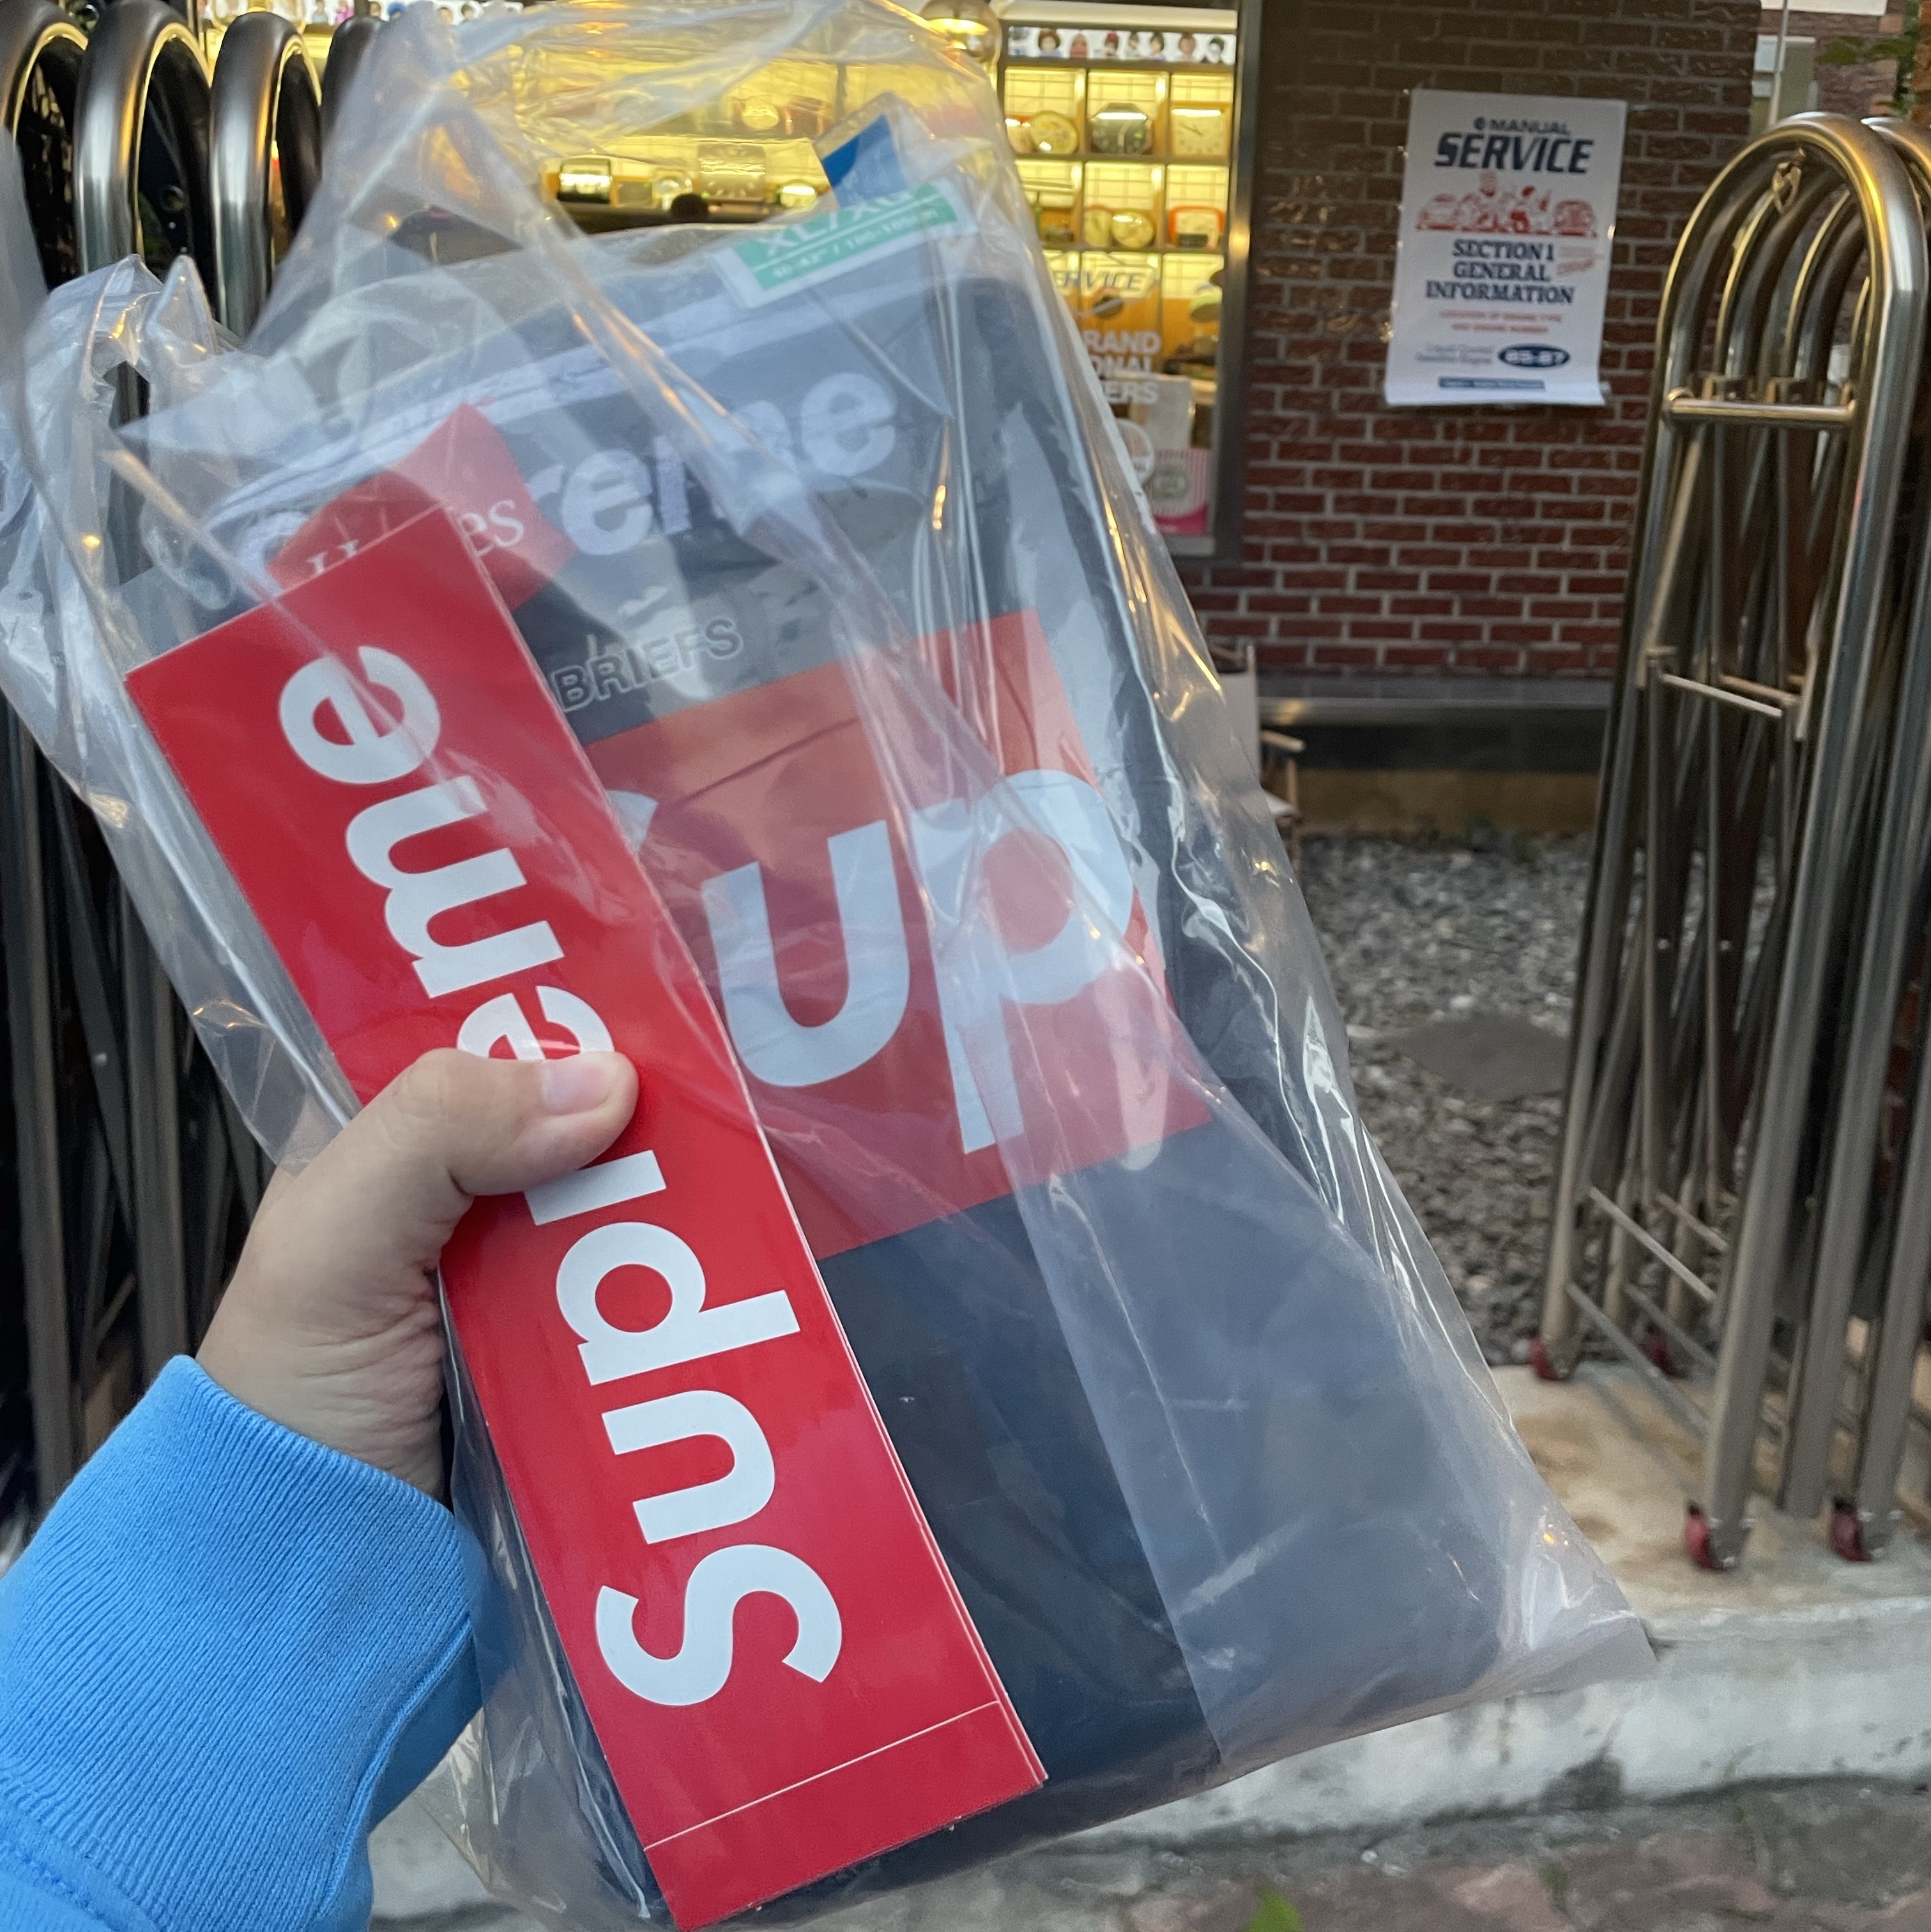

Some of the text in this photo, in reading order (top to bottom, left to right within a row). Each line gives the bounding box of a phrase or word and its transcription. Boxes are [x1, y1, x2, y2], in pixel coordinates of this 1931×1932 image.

[1434, 132, 1594, 174] SERVICE
[1052, 270, 1147, 291] ERVICE
[1453, 261, 1551, 282] GENERAL
[1426, 280, 1575, 303] INFORMATION
[1082, 330, 1163, 356] RAND
[550, 616, 744, 713] BRIEFS
[608, 768, 1134, 1155] up
